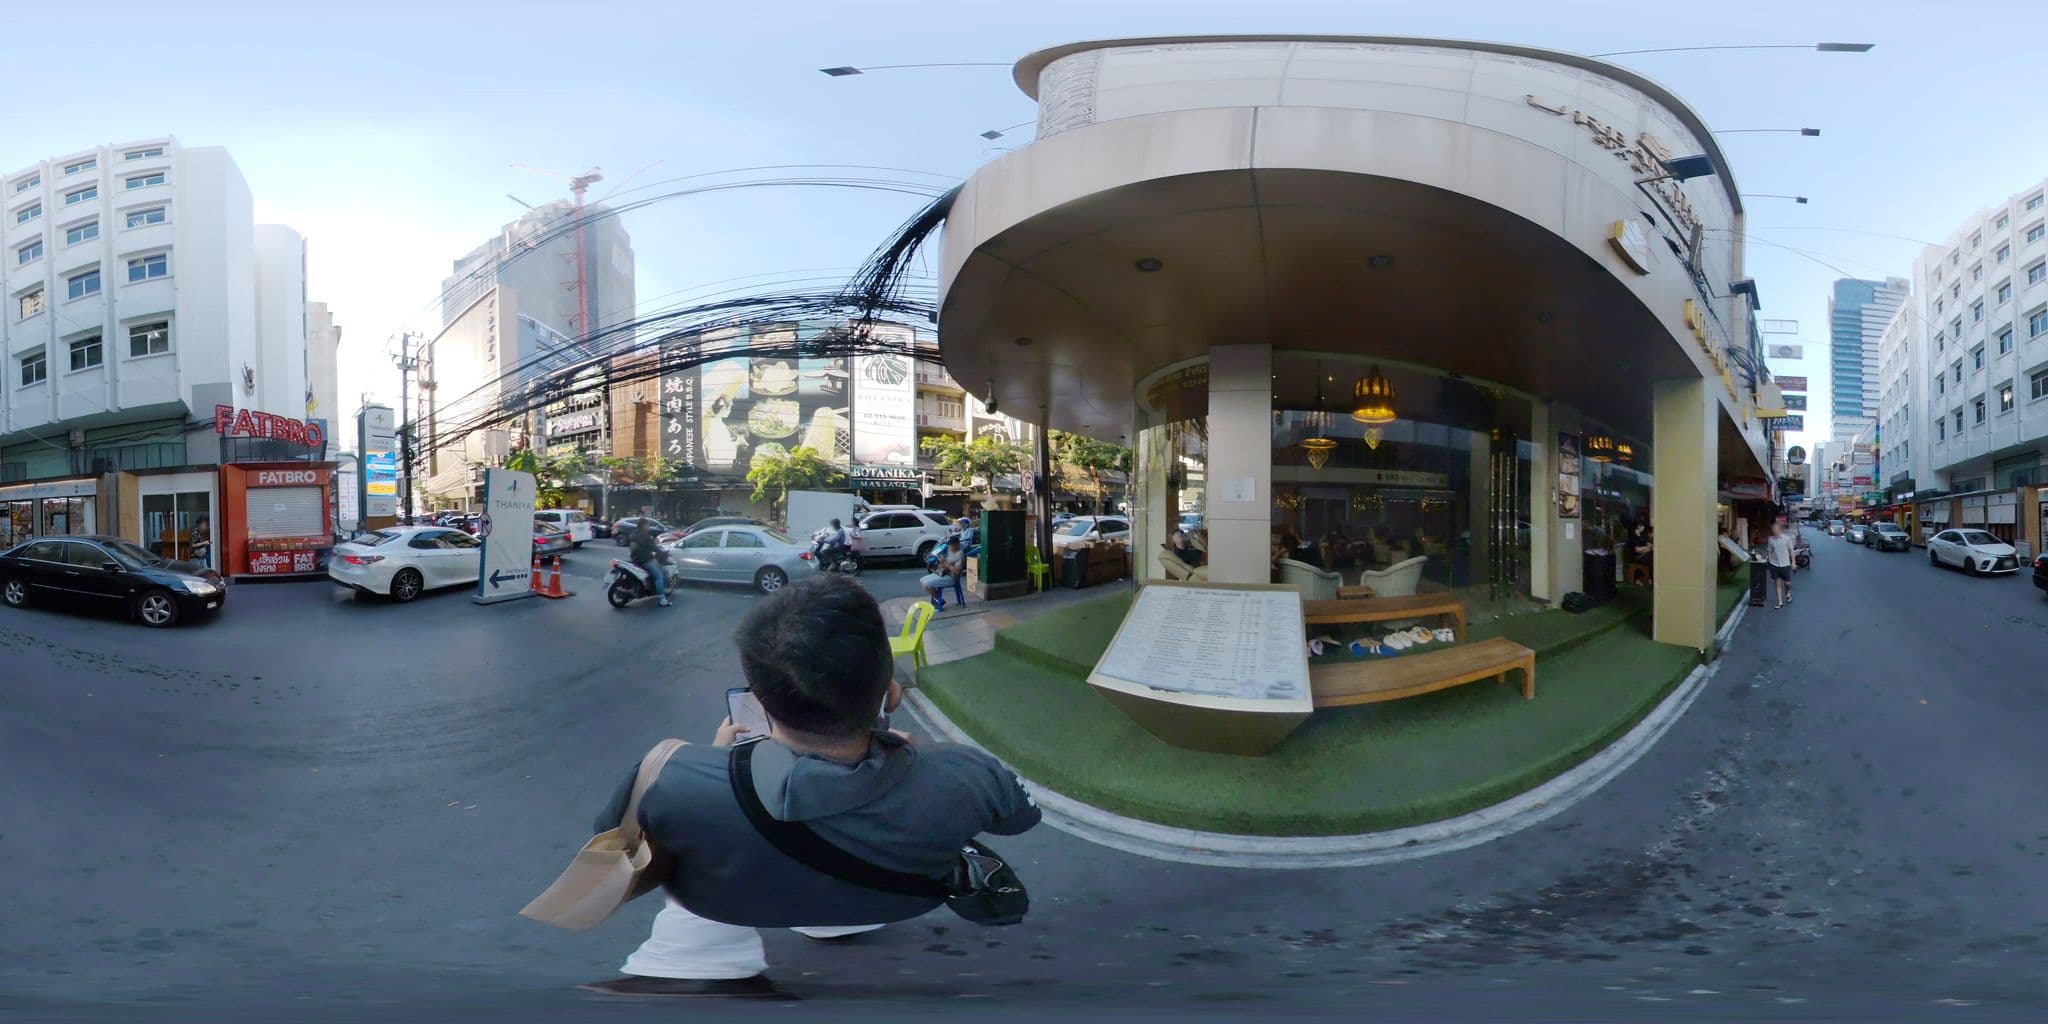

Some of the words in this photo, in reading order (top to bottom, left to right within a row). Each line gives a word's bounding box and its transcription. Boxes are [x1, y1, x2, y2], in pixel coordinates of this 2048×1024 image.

[215, 404, 322, 448] FATBRO
[259, 471, 317, 483] FATBRO
[853, 468, 916, 478] BOTANIKA
[294, 553, 315, 564] FAT
[294, 563, 315, 572] BRO
